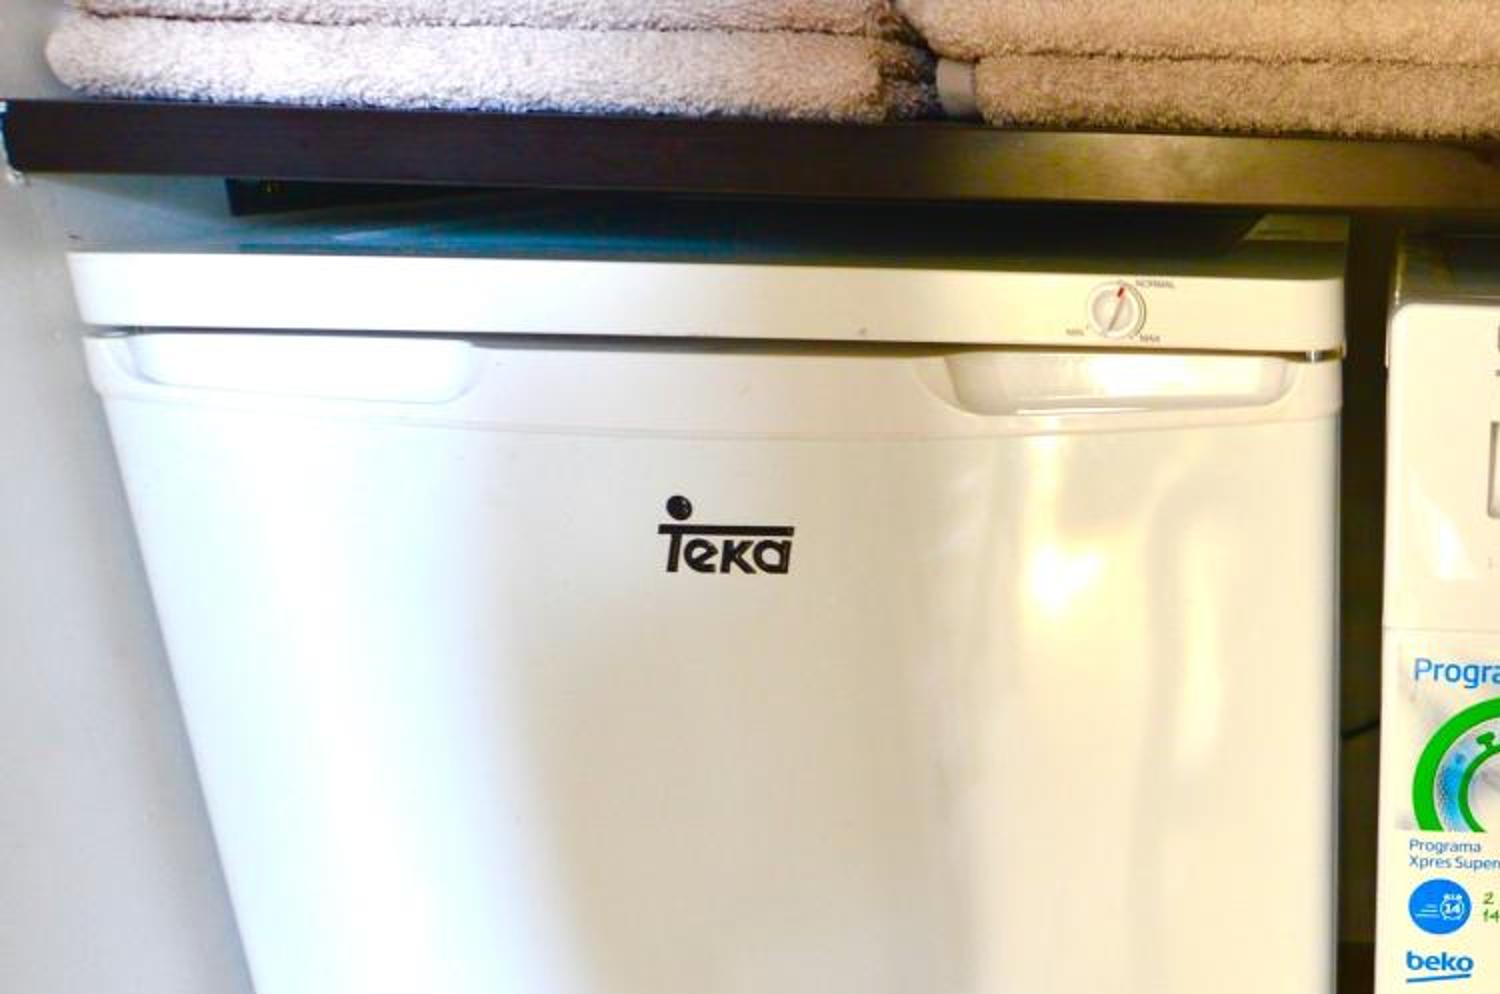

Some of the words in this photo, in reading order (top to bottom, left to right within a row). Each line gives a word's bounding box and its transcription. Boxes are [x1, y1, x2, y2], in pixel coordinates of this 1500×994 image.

[657, 494, 796, 575] Teka
[1408, 838, 1482, 854] Programa
[1408, 854, 1451, 870] Xpres
[1482, 891, 1495, 906] 2
[1442, 902, 1462, 915] 14
[1405, 950, 1475, 973] beko
